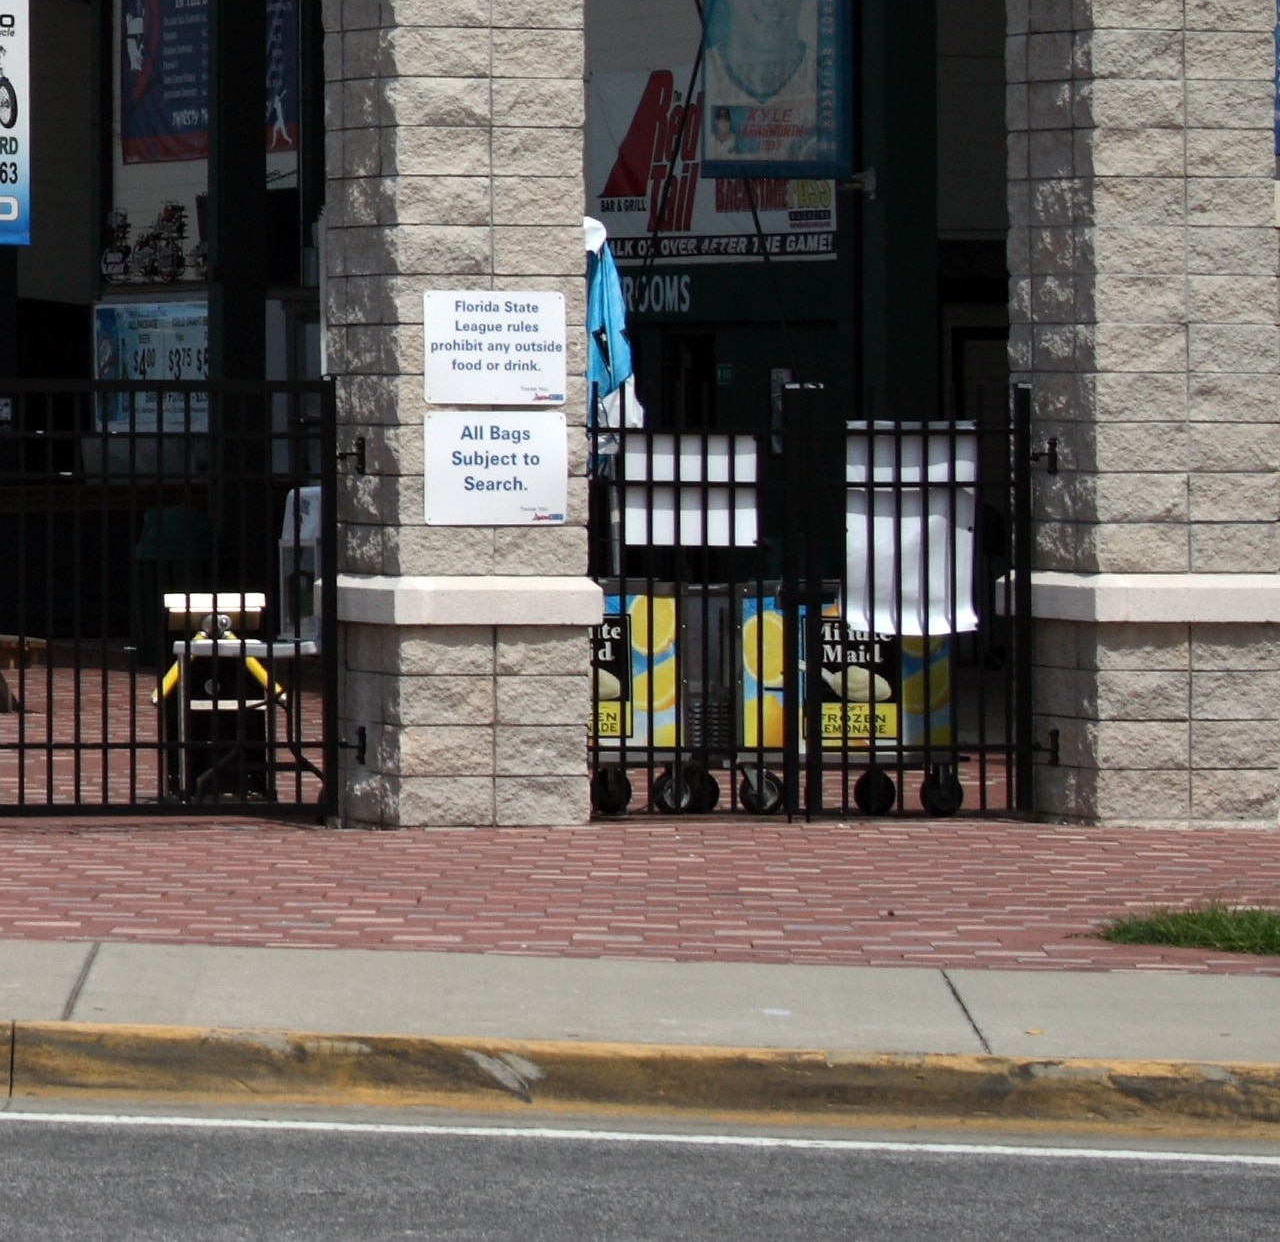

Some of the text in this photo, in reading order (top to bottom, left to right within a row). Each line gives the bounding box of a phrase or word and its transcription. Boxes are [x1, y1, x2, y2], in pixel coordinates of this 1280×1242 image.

[748, 108, 792, 123] KYLE
[0, 136, 19, 155] RD
[787, 177, 832, 209] PASS
[601, 199, 616, 212] BAR
[623, 198, 647, 212] GRILL
[609, 240, 634, 257] ALK
[660, 238, 701, 255] OVER
[701, 237, 747, 255] AFTER
[785, 233, 834, 253] GAME!
[454, 300, 539, 313] Florida State
[455, 320, 539, 334] League rules
[430, 339, 563, 354] prohibit any outside
[451, 359, 541, 371] food or drink.
[460, 425, 531, 444] All Bags
[451, 450, 540, 469] Subject to
[464, 476, 528, 491] Search.
